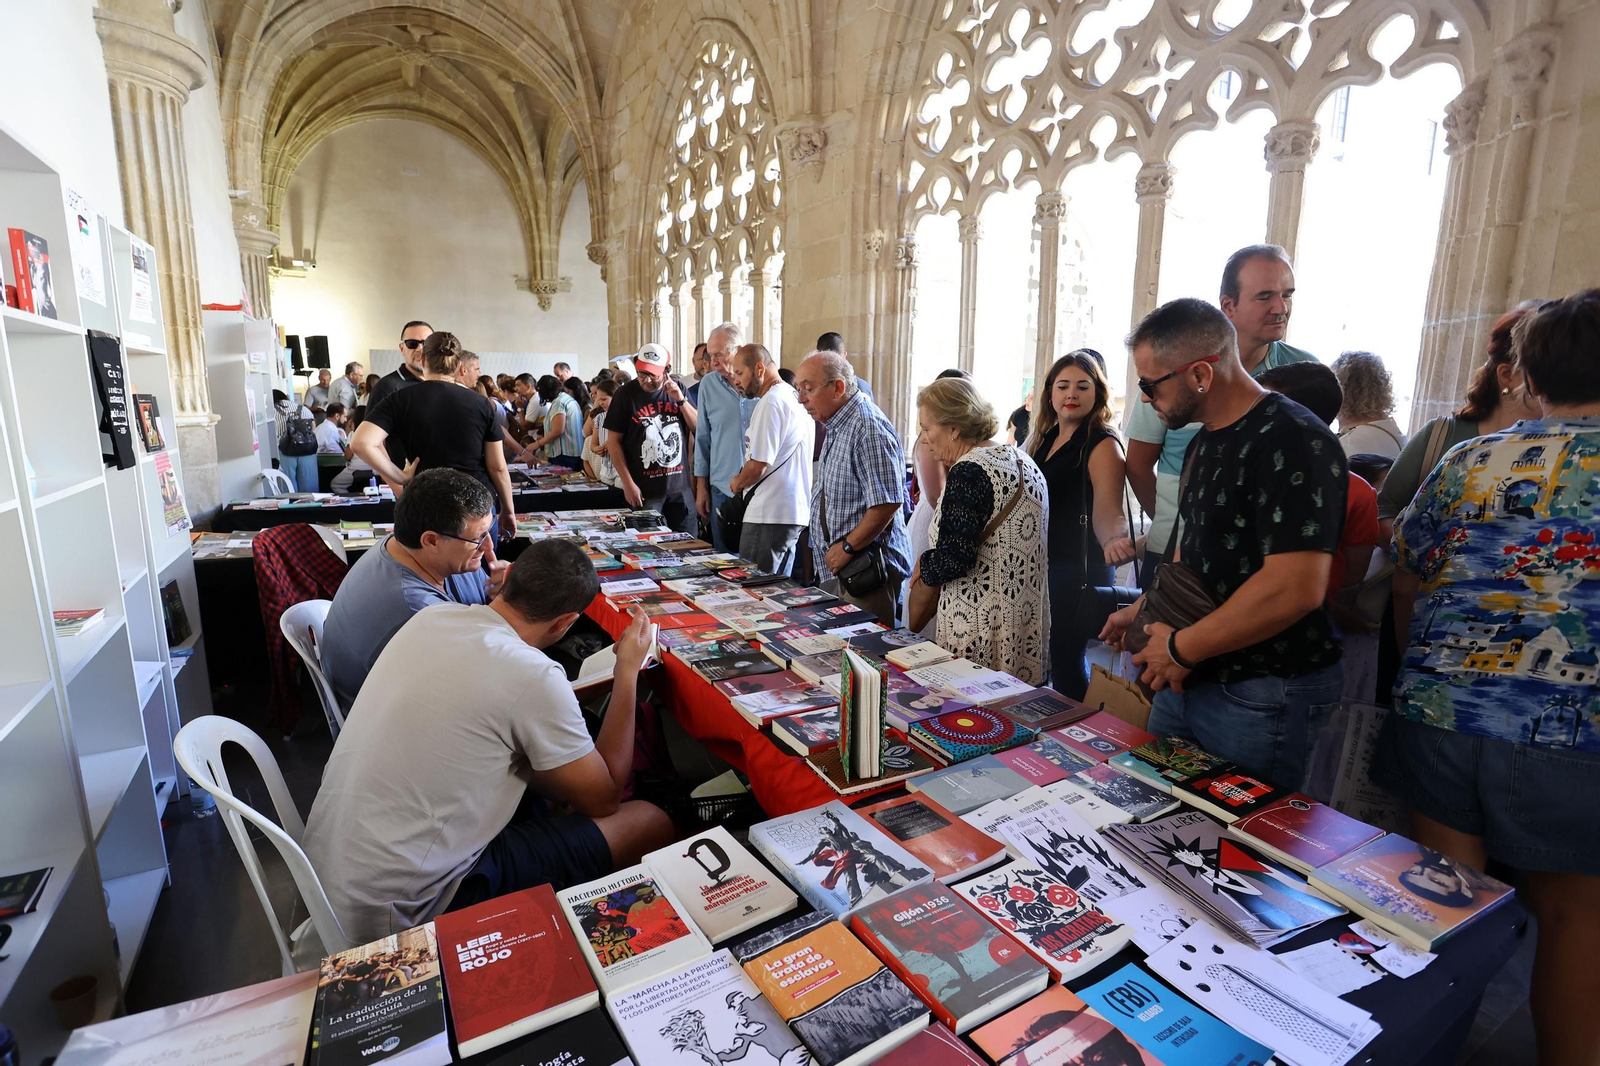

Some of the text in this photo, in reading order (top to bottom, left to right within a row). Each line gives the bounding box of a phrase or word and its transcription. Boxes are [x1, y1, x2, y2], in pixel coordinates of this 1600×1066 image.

[632, 401, 680, 424] LIVE FAS
[767, 810, 844, 838] REVOLUCIN
[1115, 813, 1206, 834] PALESTINA LIBRE
[567, 873, 645, 904] HACIENDO HISTORIA
[701, 877, 744, 897] configuración
[703, 892, 741, 911] anarquista
[743, 880, 768, 894] México
[706, 878, 755, 903] pensamiento
[893, 895, 950, 922] Gijón 1936
[901, 919, 916, 928] Diario
[456, 931, 503, 953] LEER
[458, 947, 485, 962] EN
[1035, 934, 1064, 952] LOS
[460, 949, 512, 973] ROJO
[764, 946, 814, 971] La gran
[772, 953, 824, 979] trata de
[779, 959, 835, 988] esclavos
[614, 999, 628, 1008] LA
[678, 972, 690, 981] LA
[619, 1005, 634, 1014] POR
[635, 1000, 646, 1009] LA
[646, 987, 679, 1005] LIBERTAD
[680, 981, 689, 989] DE
[689, 975, 706, 986] PEPE
[707, 962, 734, 978] BEUNZA
[628, 1009, 643, 1019] LOS
[644, 991, 684, 1013] OBJETORES
[684, 979, 711, 995] PRESOS
[1101, 979, 1160, 1019] (FBI)
[329, 984, 428, 1025] La traducción de la
[355, 1001, 403, 1024] anarquía
[338, 1022, 370, 1037] anarquismo
[378, 1011, 398, 1023] Occupy
[399, 1005, 410, 1013] Wall
[411, 1000, 426, 1009] Street
[1153, 1015, 1194, 1044] FASCISMO DE BAJA
[1170, 1027, 1199, 1048] INTENSIDAD
